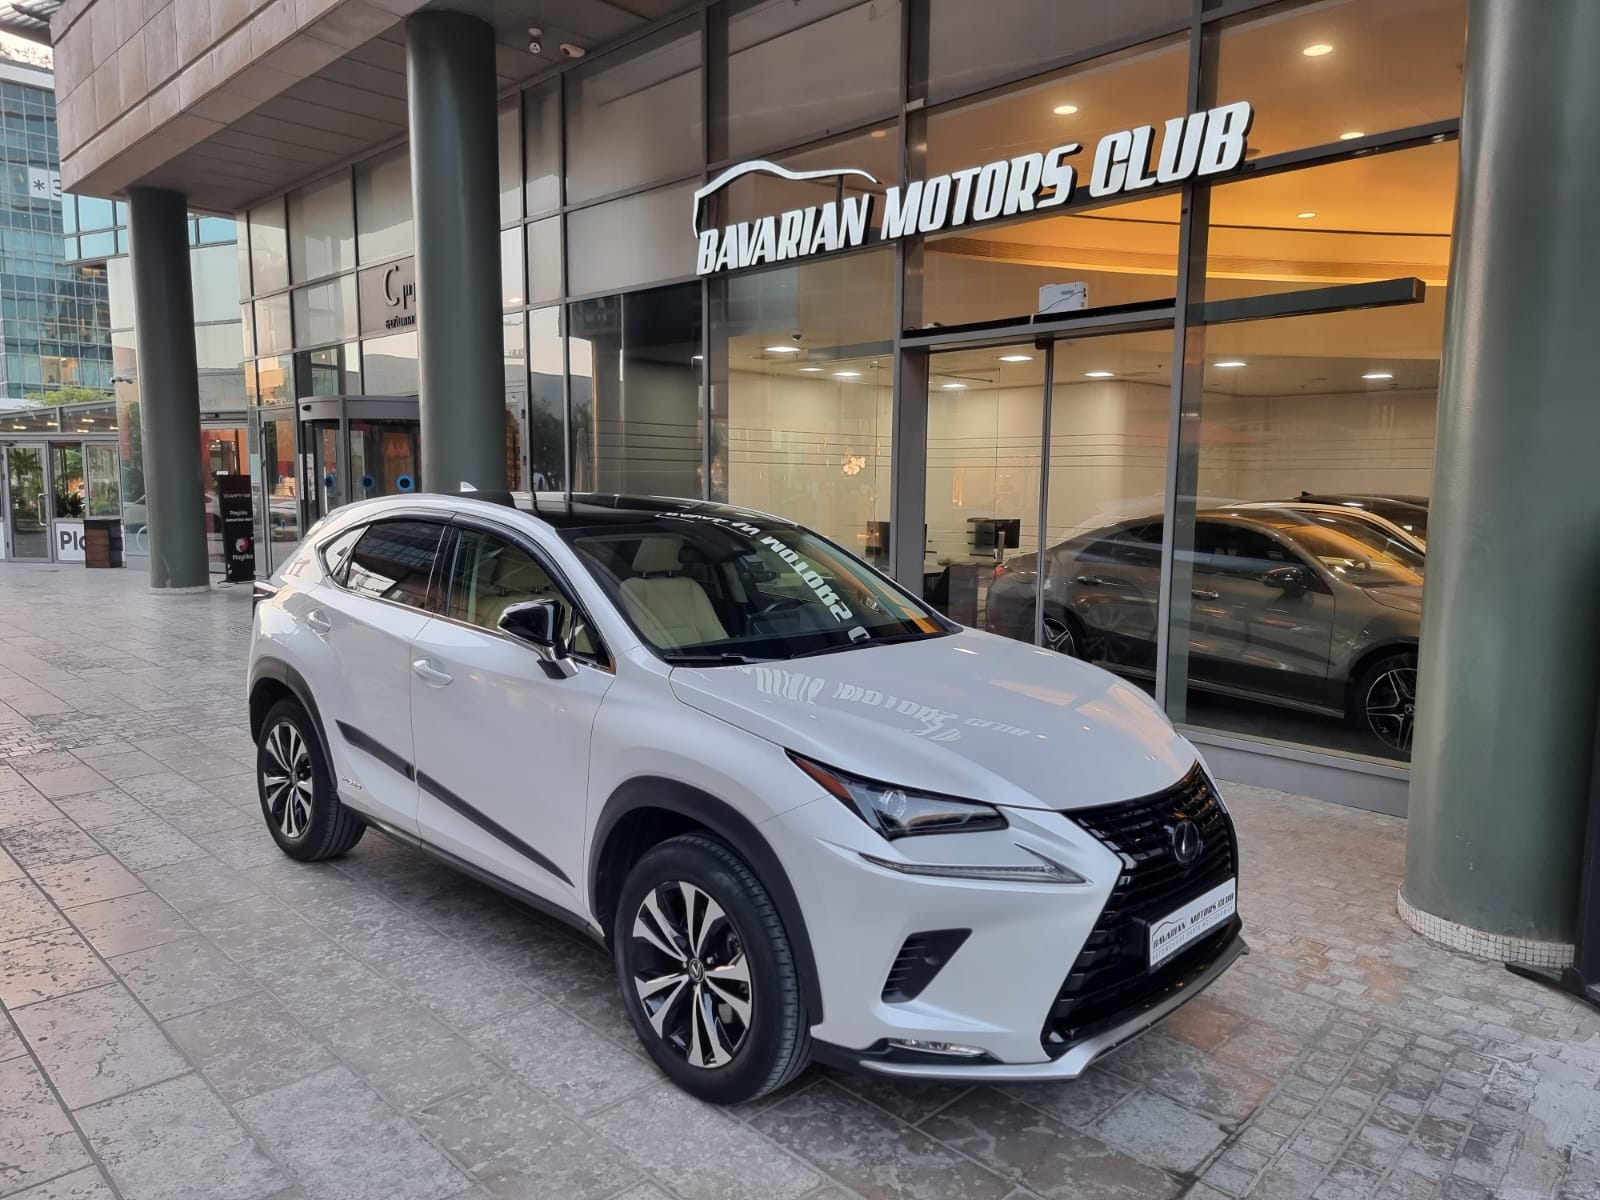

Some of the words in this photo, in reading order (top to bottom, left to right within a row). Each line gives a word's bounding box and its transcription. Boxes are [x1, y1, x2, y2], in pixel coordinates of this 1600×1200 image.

[695, 193, 874, 276] BAVARIAN
[880, 142, 1082, 241] MOTORS
[1088, 101, 1253, 198] CLUB
